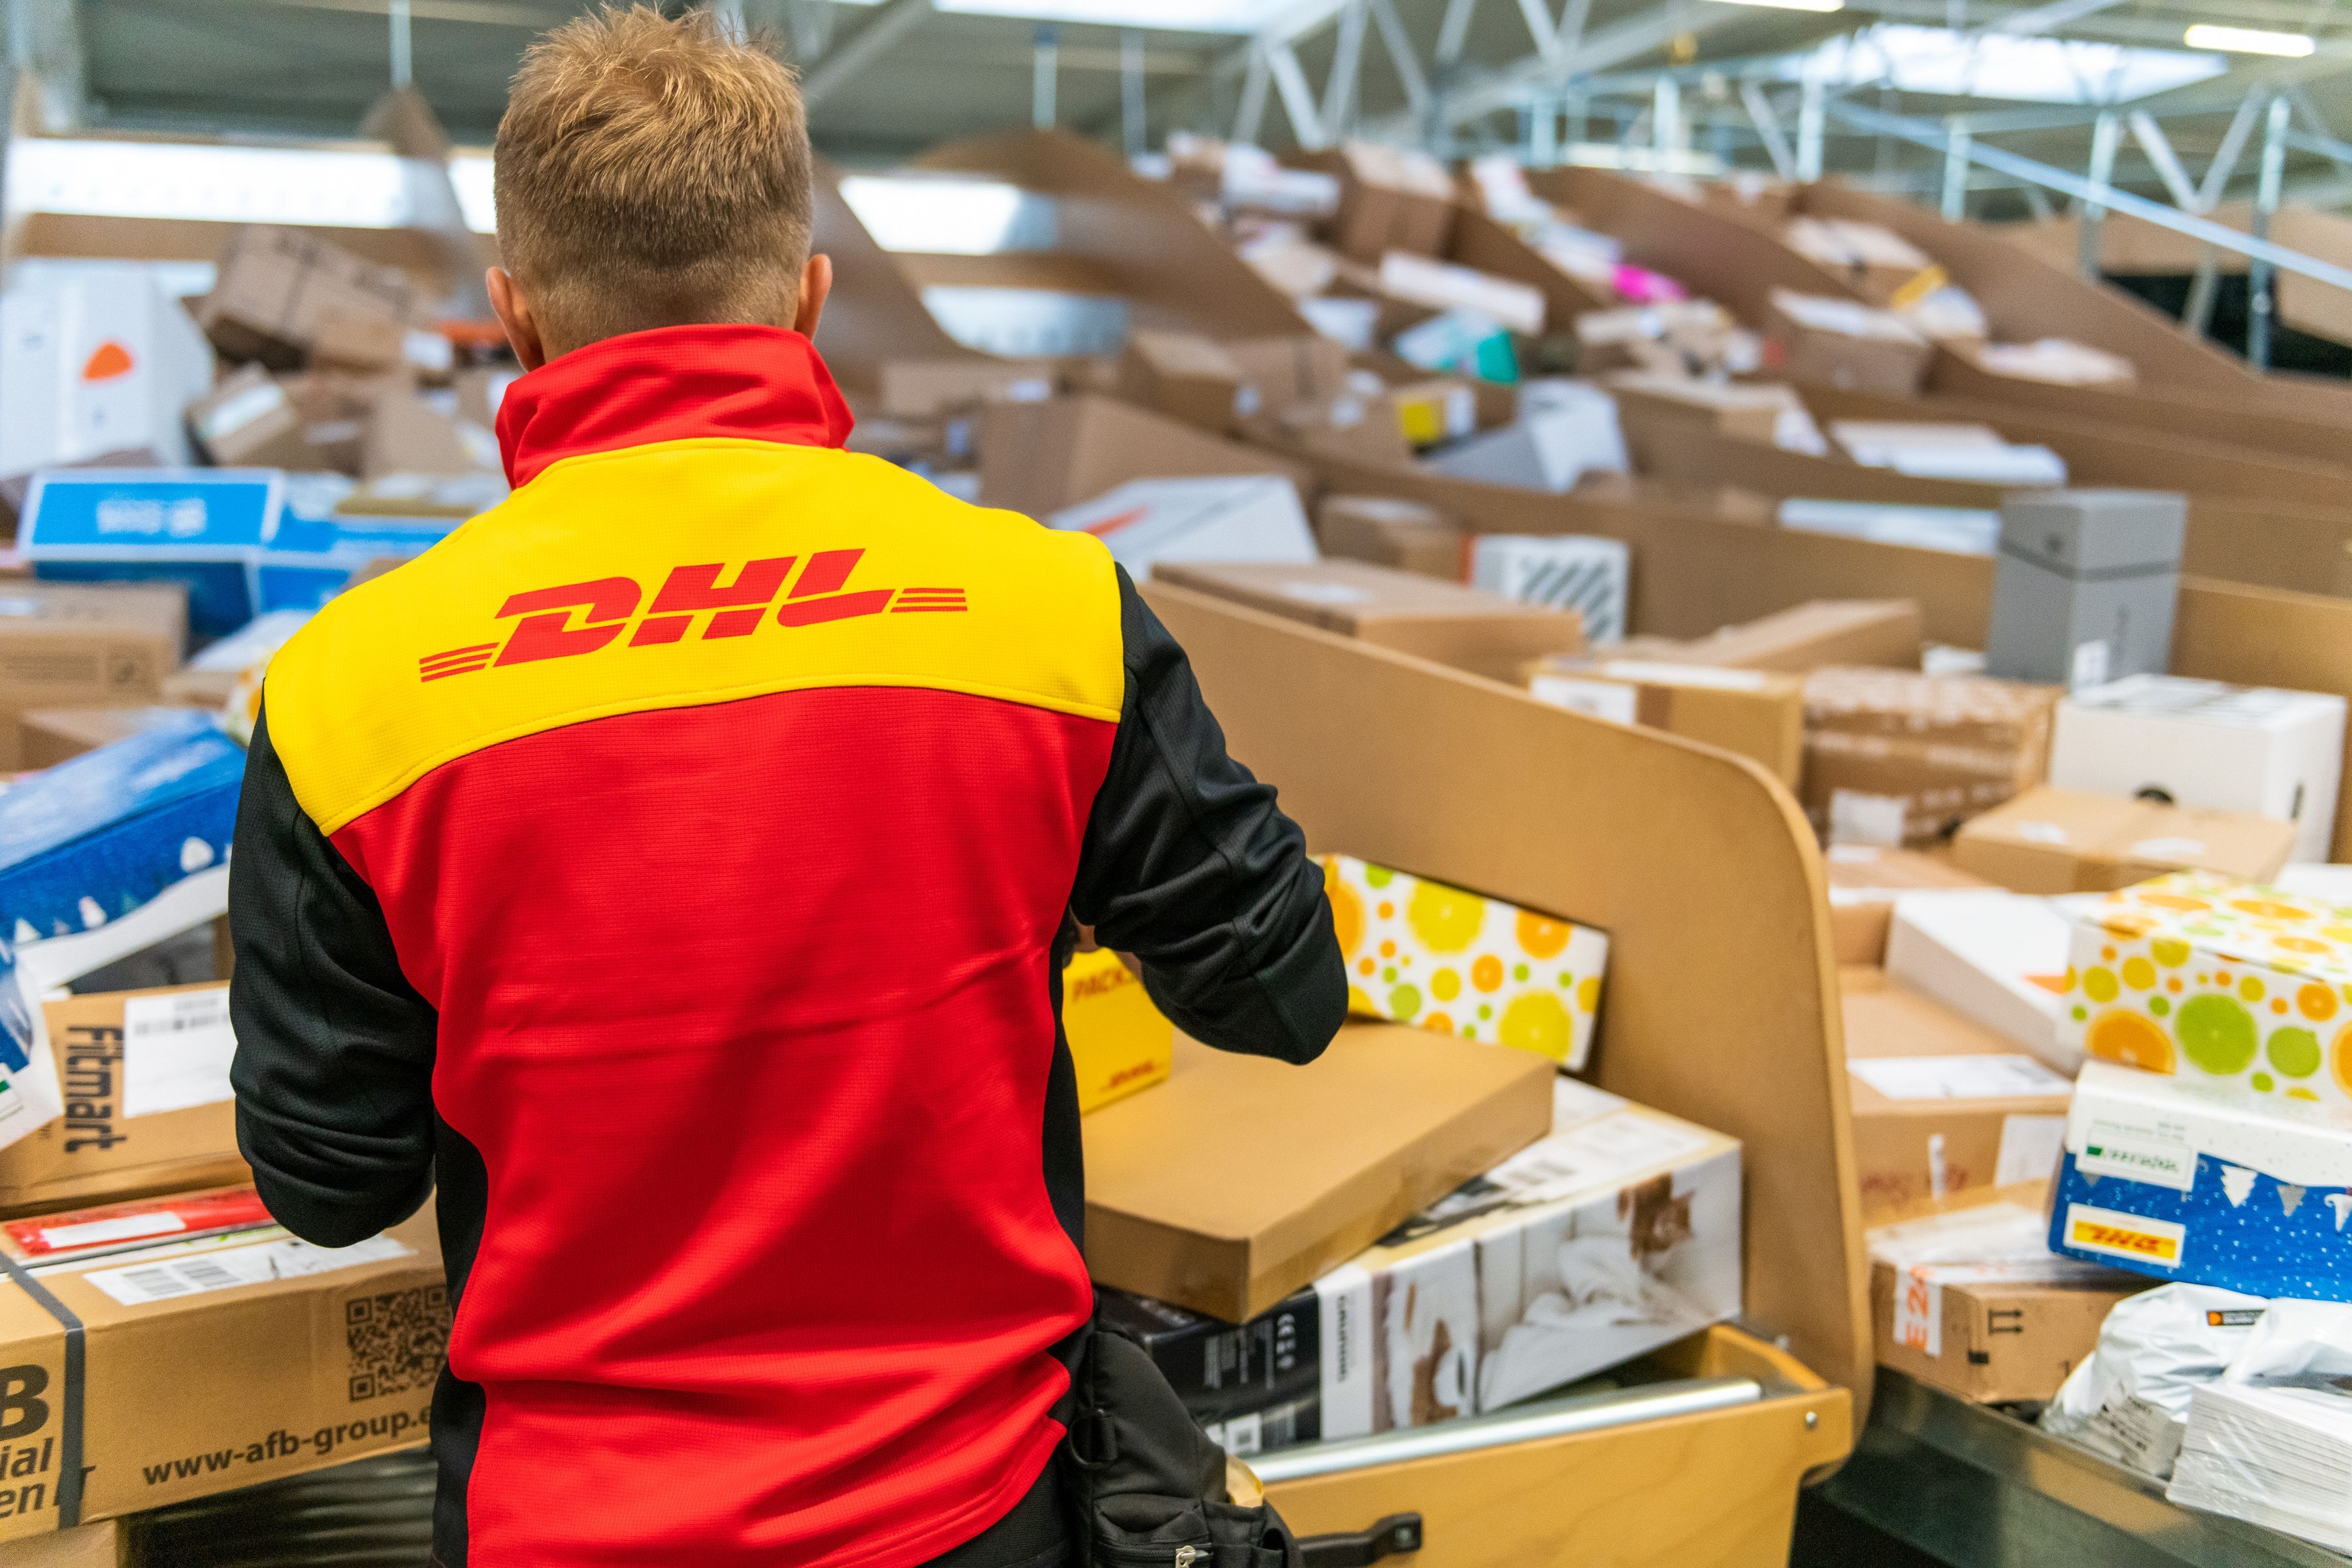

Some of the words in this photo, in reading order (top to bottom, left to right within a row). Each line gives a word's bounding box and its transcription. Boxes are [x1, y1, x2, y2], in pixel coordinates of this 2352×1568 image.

[493, 548, 895, 667] DHL
[64, 1024, 127, 1152] Fitmart
[2089, 1226, 2160, 1253] DHL
[0, 1364, 49, 1441] B
[0, 1437, 54, 1481] ial
